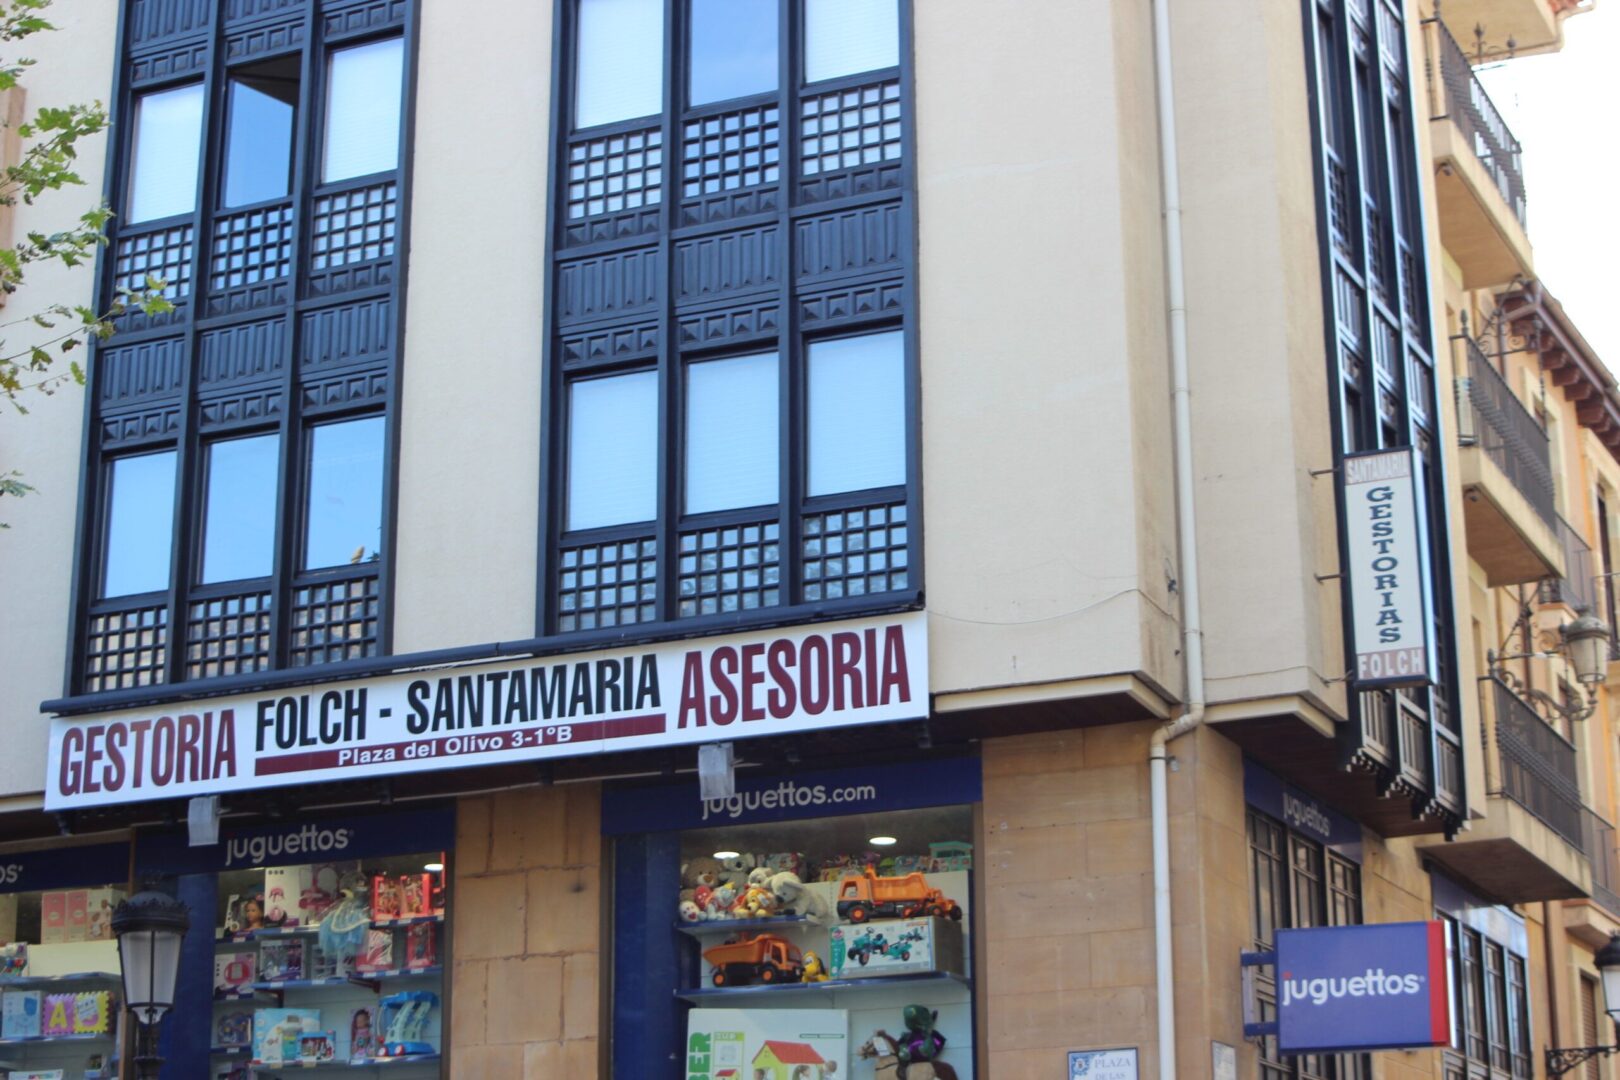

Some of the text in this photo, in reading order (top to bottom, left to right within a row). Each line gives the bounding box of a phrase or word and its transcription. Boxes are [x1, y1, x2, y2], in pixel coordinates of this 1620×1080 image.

[1366, 486, 1403, 643] GESTORIAS
[1358, 649, 1424, 680] FOLCH
[58, 709, 238, 797] GESTORIA
[254, 687, 368, 752] FOLCH
[406, 653, 662, 735] SANTAMARIA
[677, 624, 911, 729] ASESORIA
[338, 748, 396, 766] Plaza
[403, 740, 437, 759] del
[445, 735, 503, 754] Olivo
[225, 824, 349, 866] juguettos
[1282, 968, 1420, 1006] juguettos
[688, 1032, 711, 1080] ER
[1094, 1057, 1131, 1068] PLAZA
